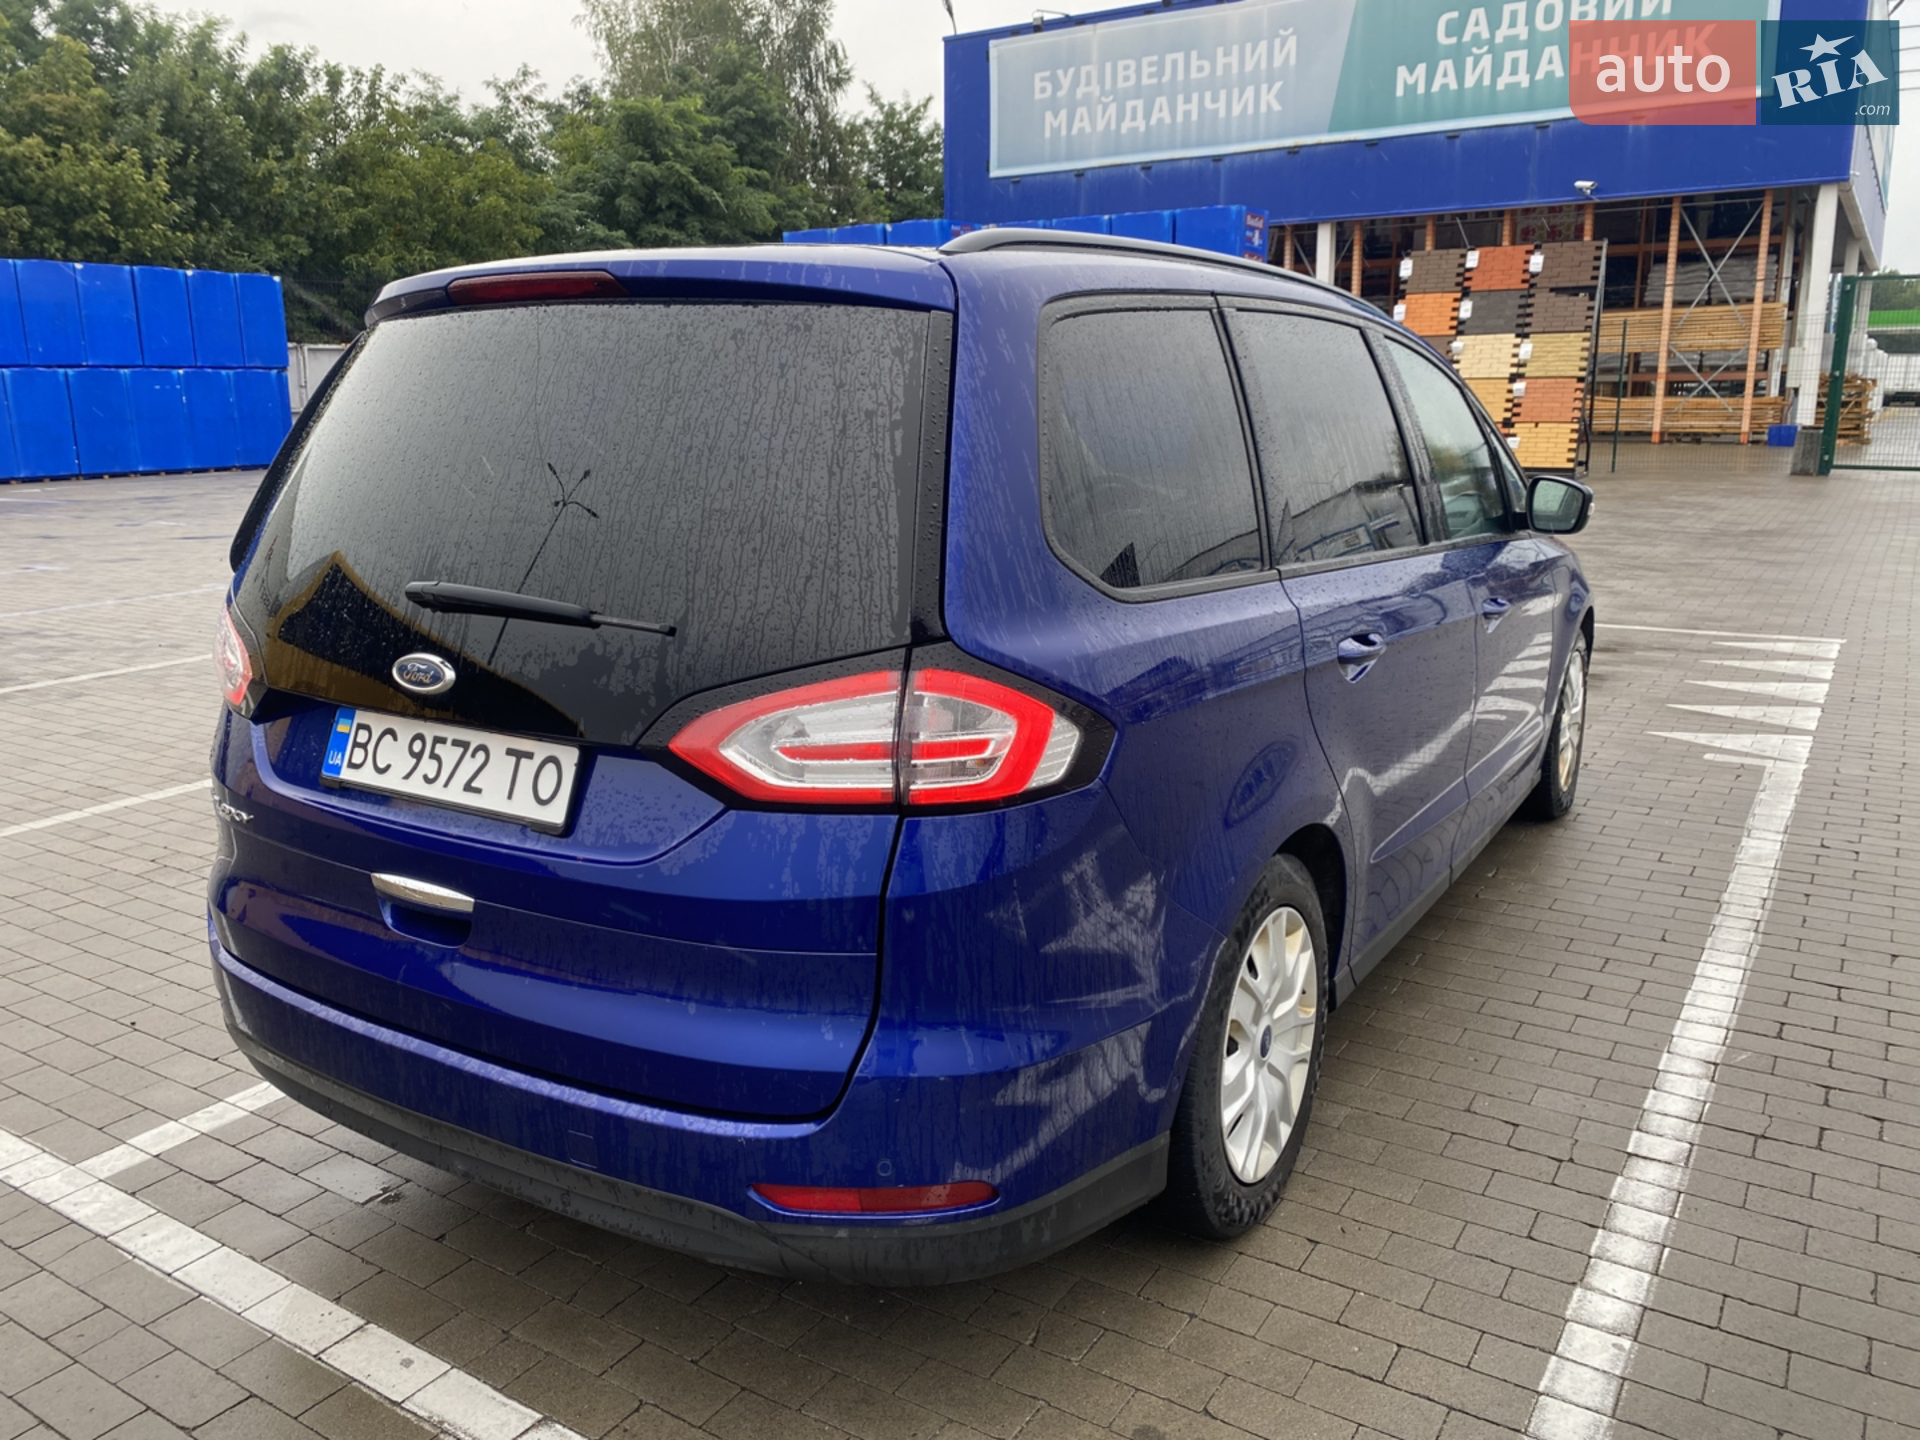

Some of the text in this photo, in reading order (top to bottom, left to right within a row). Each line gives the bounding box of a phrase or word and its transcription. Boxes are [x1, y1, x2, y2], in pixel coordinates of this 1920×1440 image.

[1033, 27, 1298, 100] БУДІВЕЛЬНИЙ
[1396, 23, 1718, 97] МАЙДАНЧИК
[1044, 81, 1284, 138] МАЙДАНЧИК
[403, 662, 435, 684] Ford
[328, 750, 342, 766] UA
[346, 722, 563, 806] BC 9572 TO
